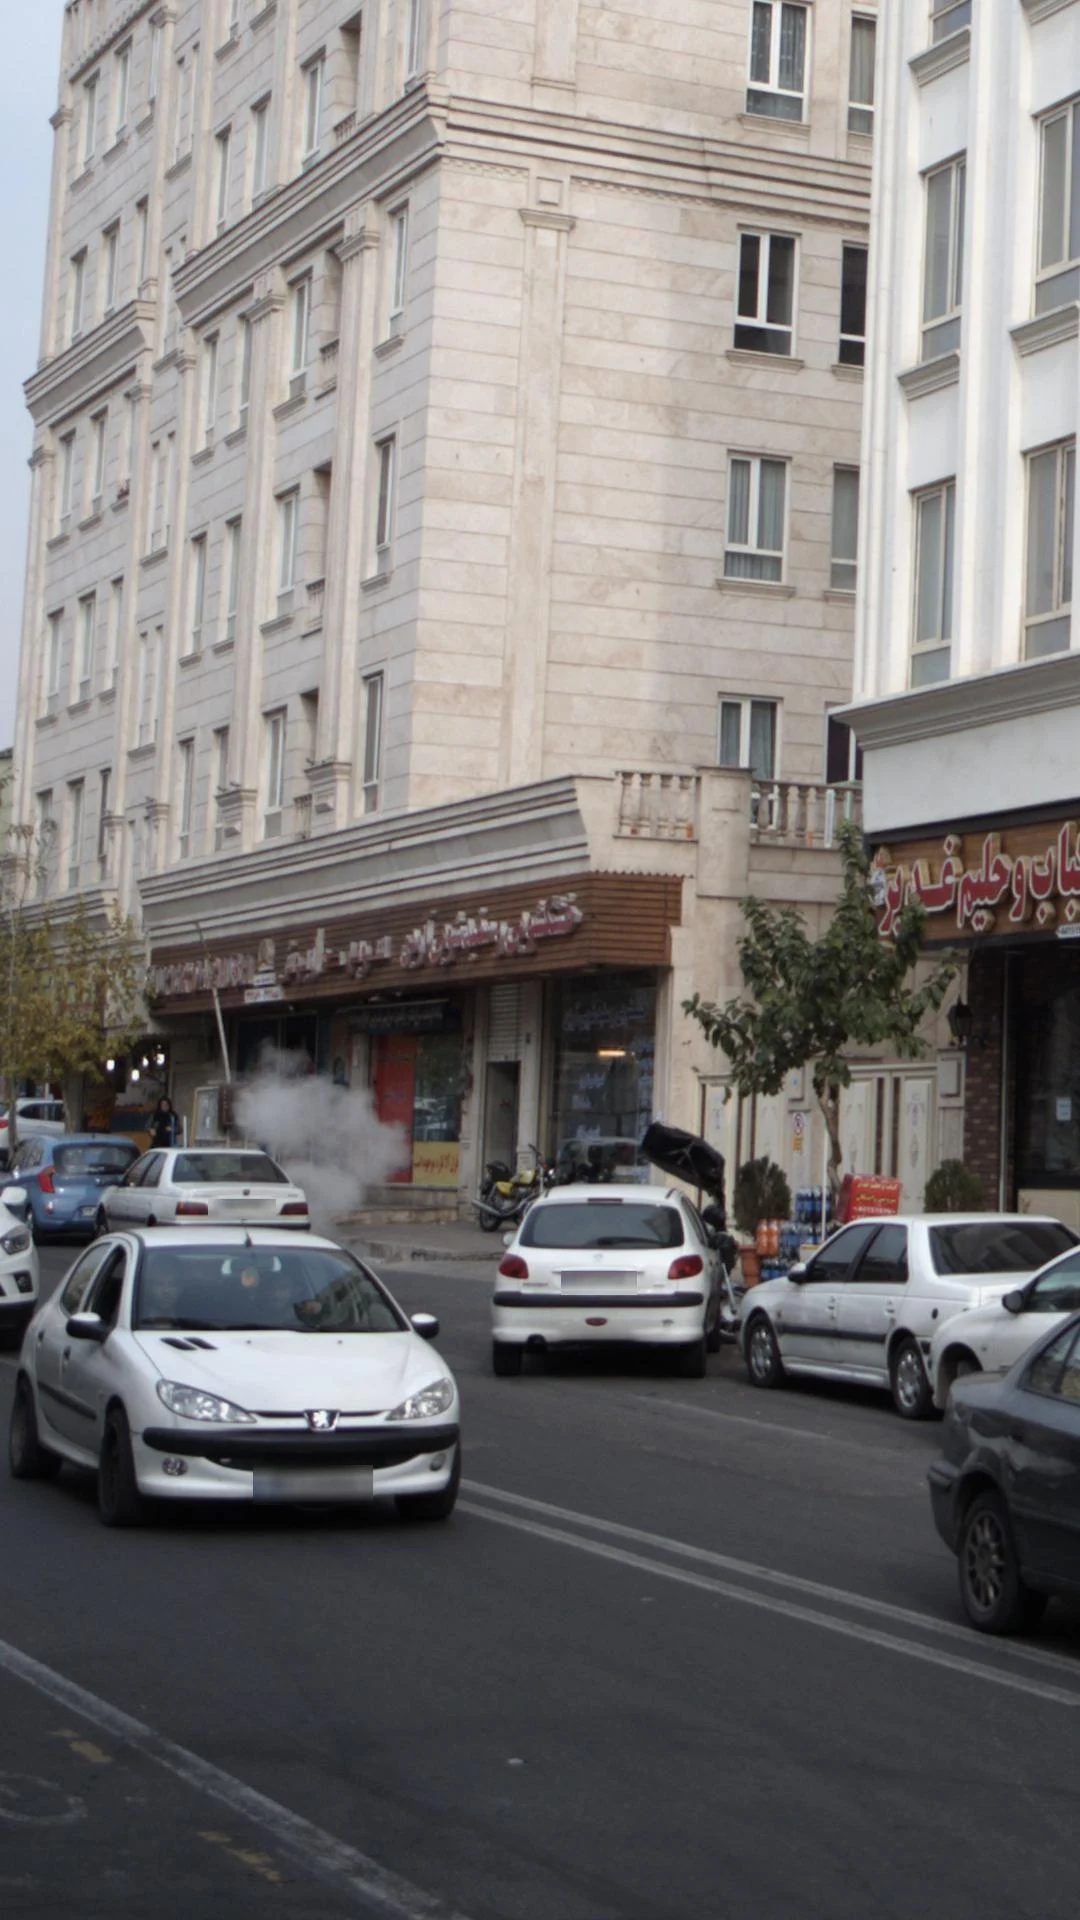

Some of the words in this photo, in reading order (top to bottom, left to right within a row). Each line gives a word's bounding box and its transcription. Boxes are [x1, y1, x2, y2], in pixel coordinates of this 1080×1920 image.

[957, 833, 1012, 932] حلیم
[1009, 857, 1028, 922] و
[1029, 821, 1080, 924] باب
